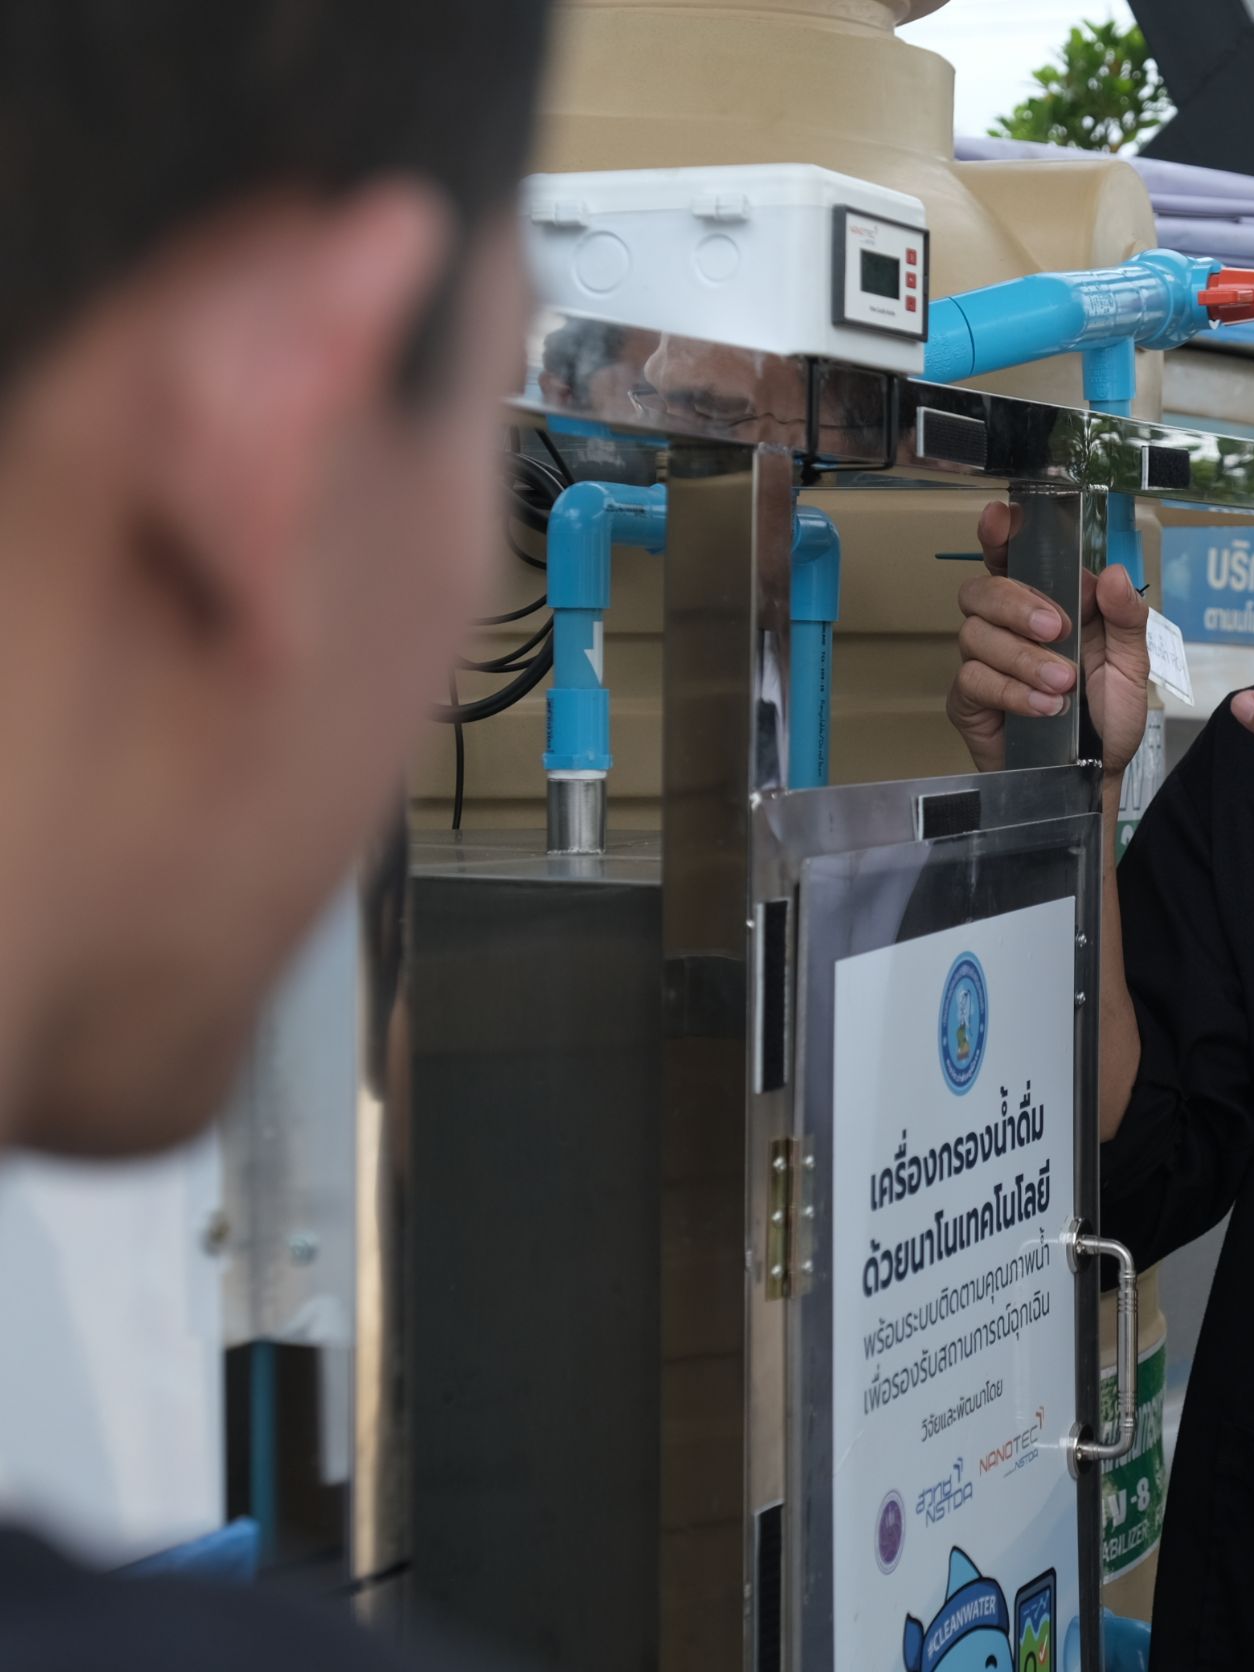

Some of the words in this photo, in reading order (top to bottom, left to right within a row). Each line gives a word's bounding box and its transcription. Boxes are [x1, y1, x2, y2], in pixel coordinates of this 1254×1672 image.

[870, 1080, 1044, 1212] เครื่องกรองน้ำดื่ม
[862, 1158, 1050, 1298] ด้วยนาโนเทคโนโลยี
[863, 1227, 1050, 1360] พร้อมระบบติดตามคุณภาพน้ำ
[863, 1290, 1050, 1415] เพื่อรองรับสถานการณ์ฉุกเฉิน
[921, 1378, 1004, 1442] วิจัยและพัฒนาโดย
[979, 1424, 1039, 1476] NANOTEC
[925, 1482, 973, 1529] NSTDA
[1102, 1519, 1149, 1562] ABILIZER
[927, 1595, 997, 1658] #CLEANWATER
